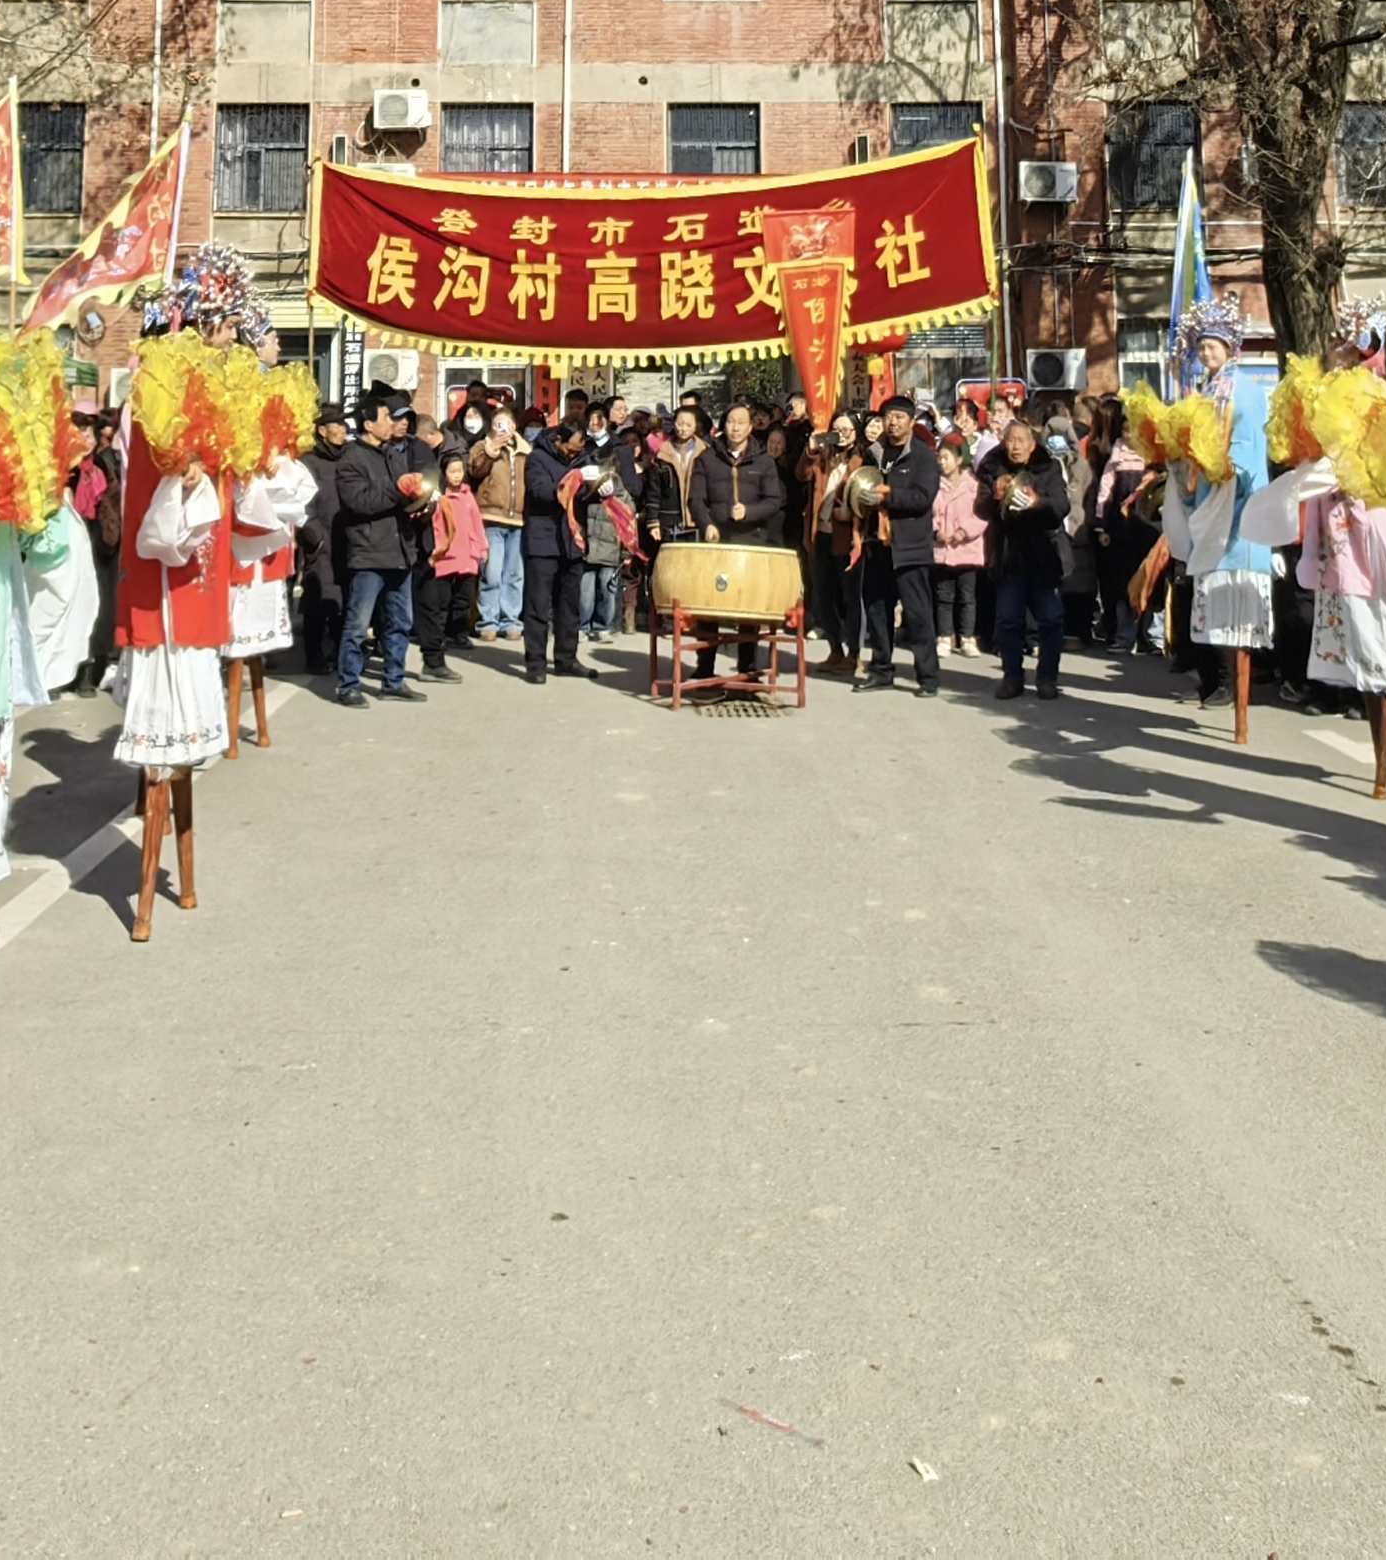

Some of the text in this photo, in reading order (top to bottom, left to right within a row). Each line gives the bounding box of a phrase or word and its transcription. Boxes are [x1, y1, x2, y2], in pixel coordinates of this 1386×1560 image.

[429, 197, 853, 246] 登封市石道
[366, 214, 932, 323] 侯沟村高跷文社
